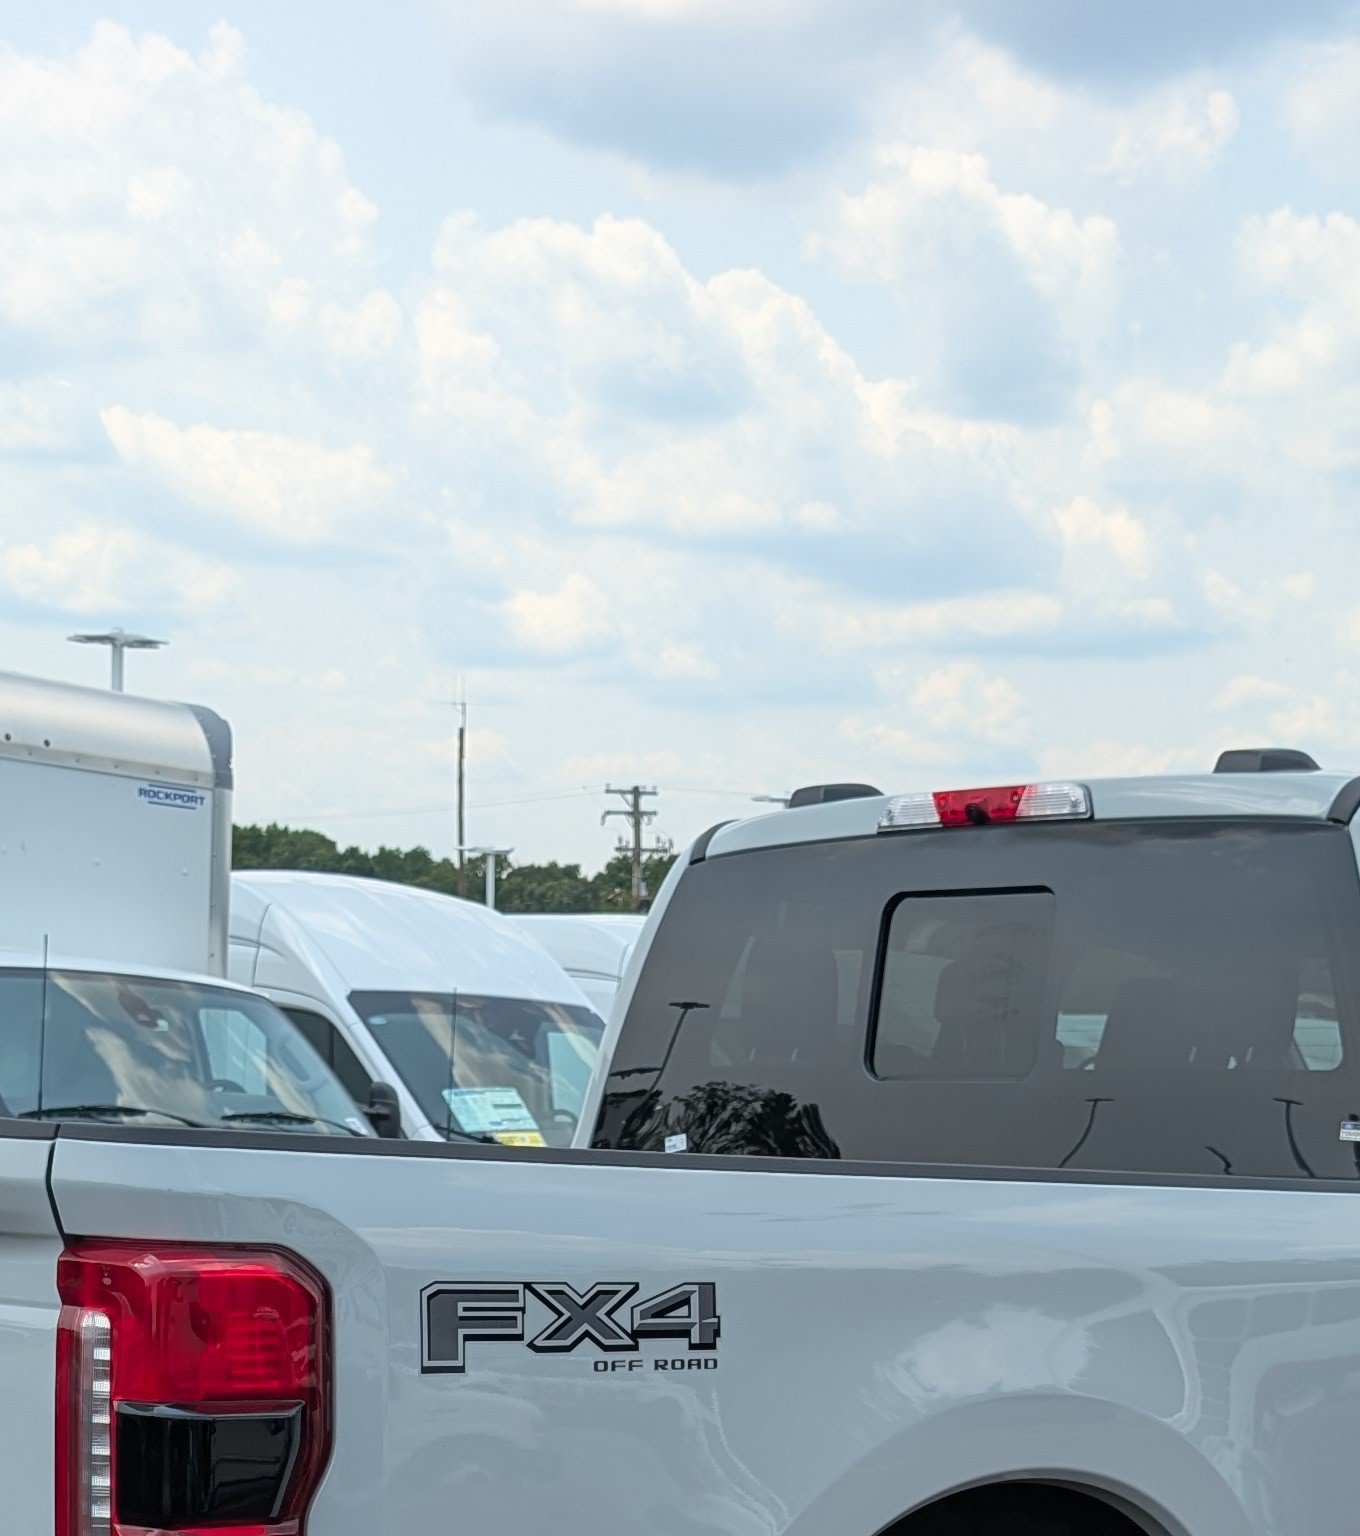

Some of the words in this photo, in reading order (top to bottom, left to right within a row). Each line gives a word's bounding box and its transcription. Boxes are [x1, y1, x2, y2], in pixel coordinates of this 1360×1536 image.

[138, 787, 206, 806] ROCKPORT
[420, 1280, 721, 1375] FX4
[593, 1359, 644, 1373] OFF
[654, 1358, 719, 1371] ROAD
